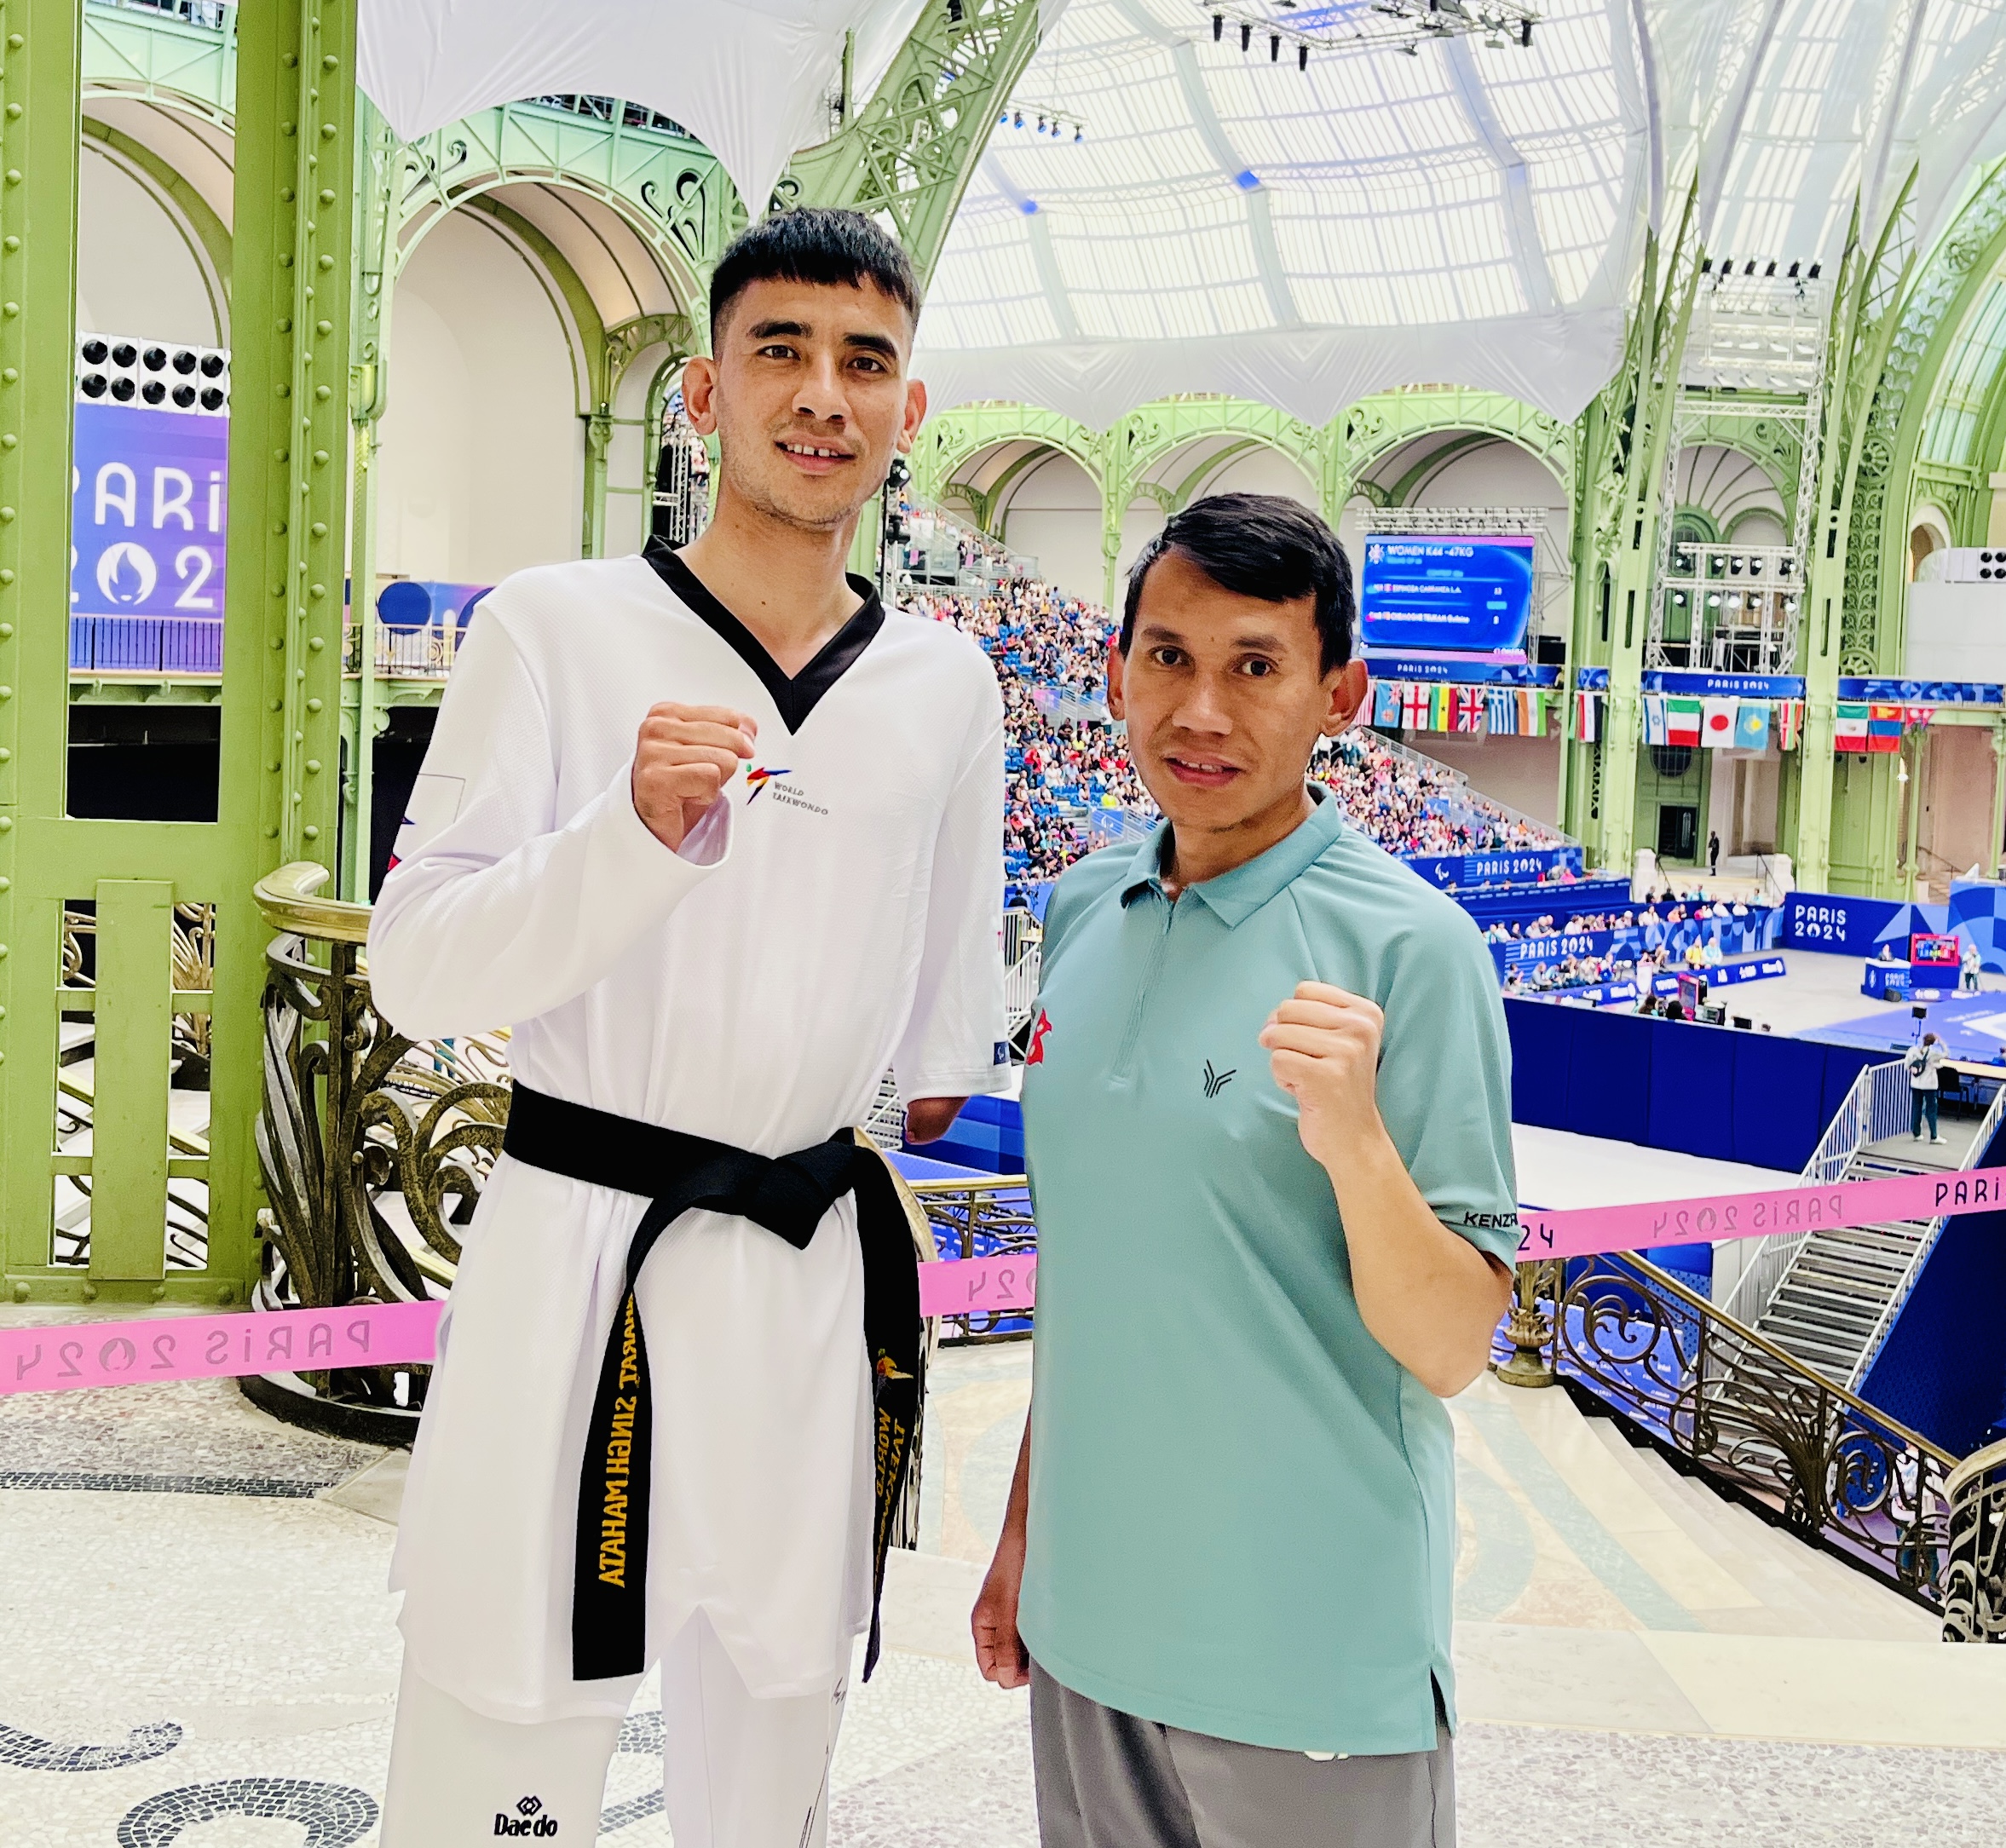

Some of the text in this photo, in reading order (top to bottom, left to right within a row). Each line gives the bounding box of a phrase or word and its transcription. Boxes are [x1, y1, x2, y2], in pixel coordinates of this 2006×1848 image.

[72, 461, 221, 533] ARi
[1386, 545, 1425, 556] WOMEN
[1398, 664, 1448, 674] PARIS 2024
[1708, 679, 1769, 690] PARIS 2024
[775, 781, 804, 797] WORLD
[772, 792, 829, 815] TAEKWONDO
[1477, 857, 1542, 876] PARIS 2024
[1795, 904, 1847, 925] PARIS
[1795, 920, 1846, 942] 2024
[1519, 935, 1594, 960] PARIS 2024
[493, 1813, 558, 1837] Daedo
